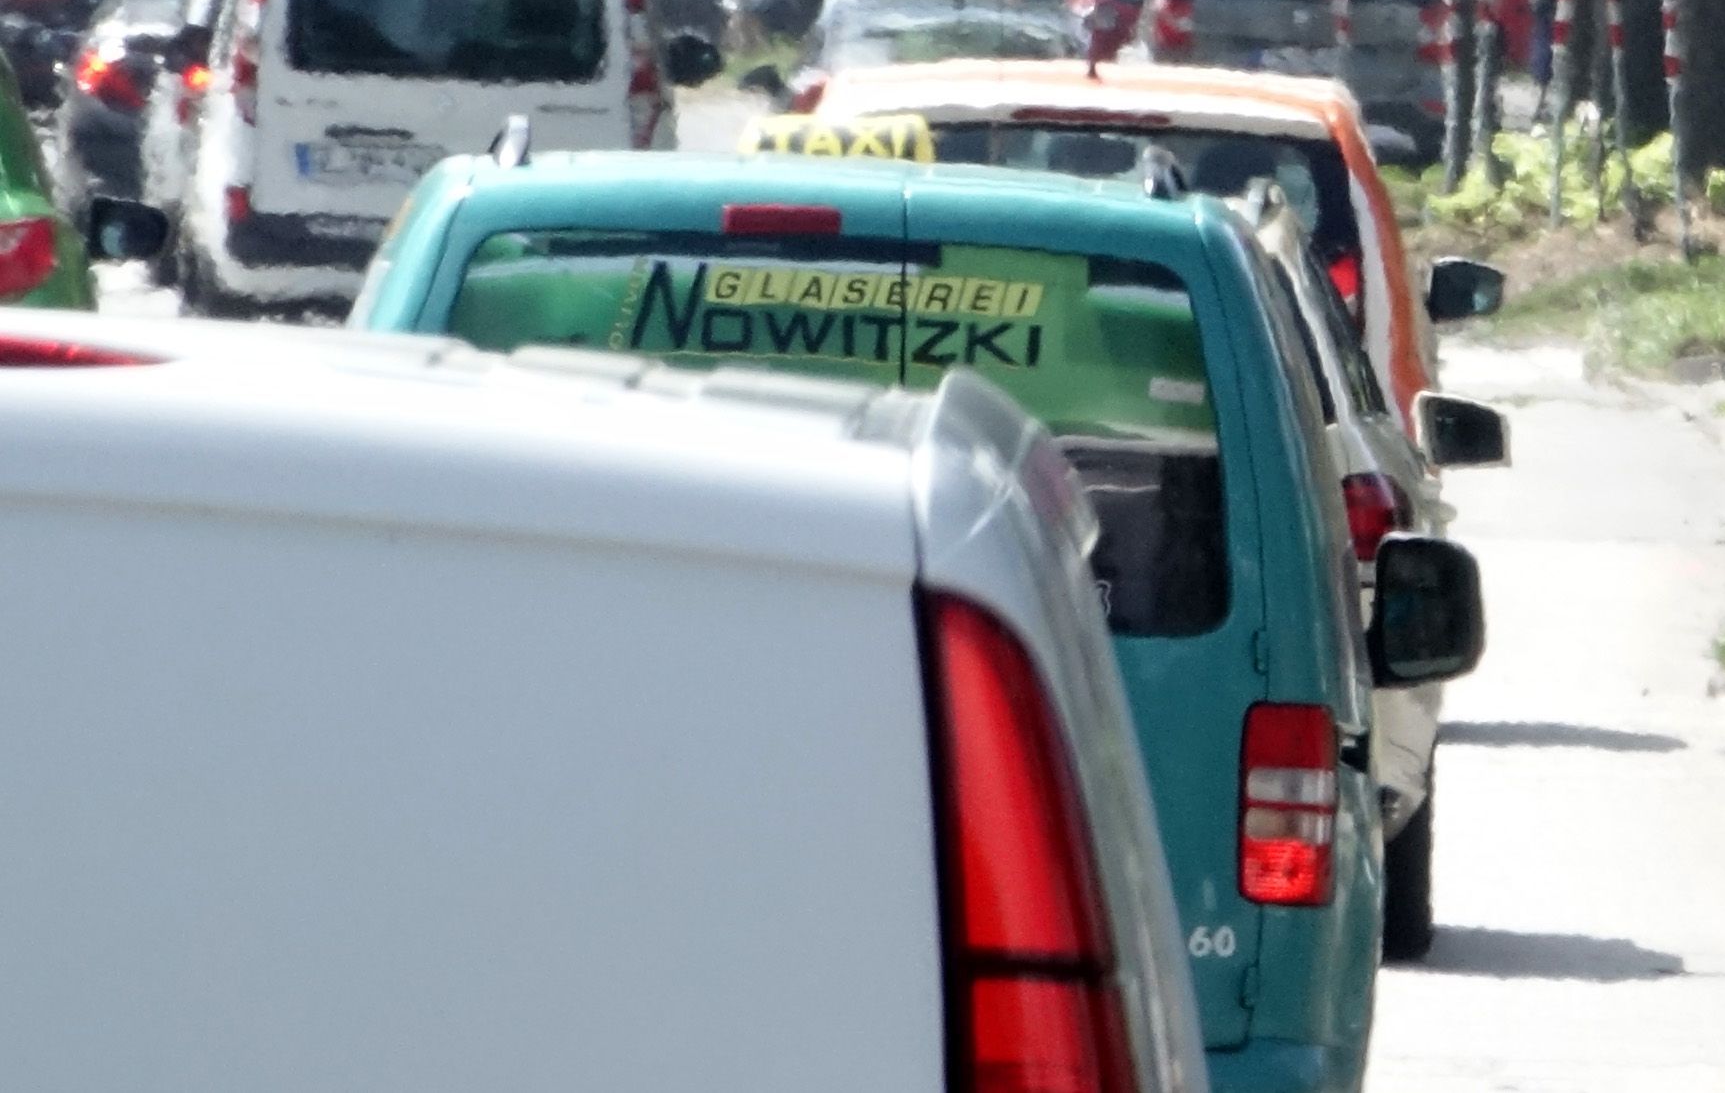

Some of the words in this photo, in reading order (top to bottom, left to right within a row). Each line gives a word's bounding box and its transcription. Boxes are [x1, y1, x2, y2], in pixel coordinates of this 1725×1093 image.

[758, 117, 912, 158] TAXI
[713, 270, 1029, 314] GLASEREI
[630, 260, 1043, 368] NOWITZKI
[1187, 925, 1236, 958] 60
